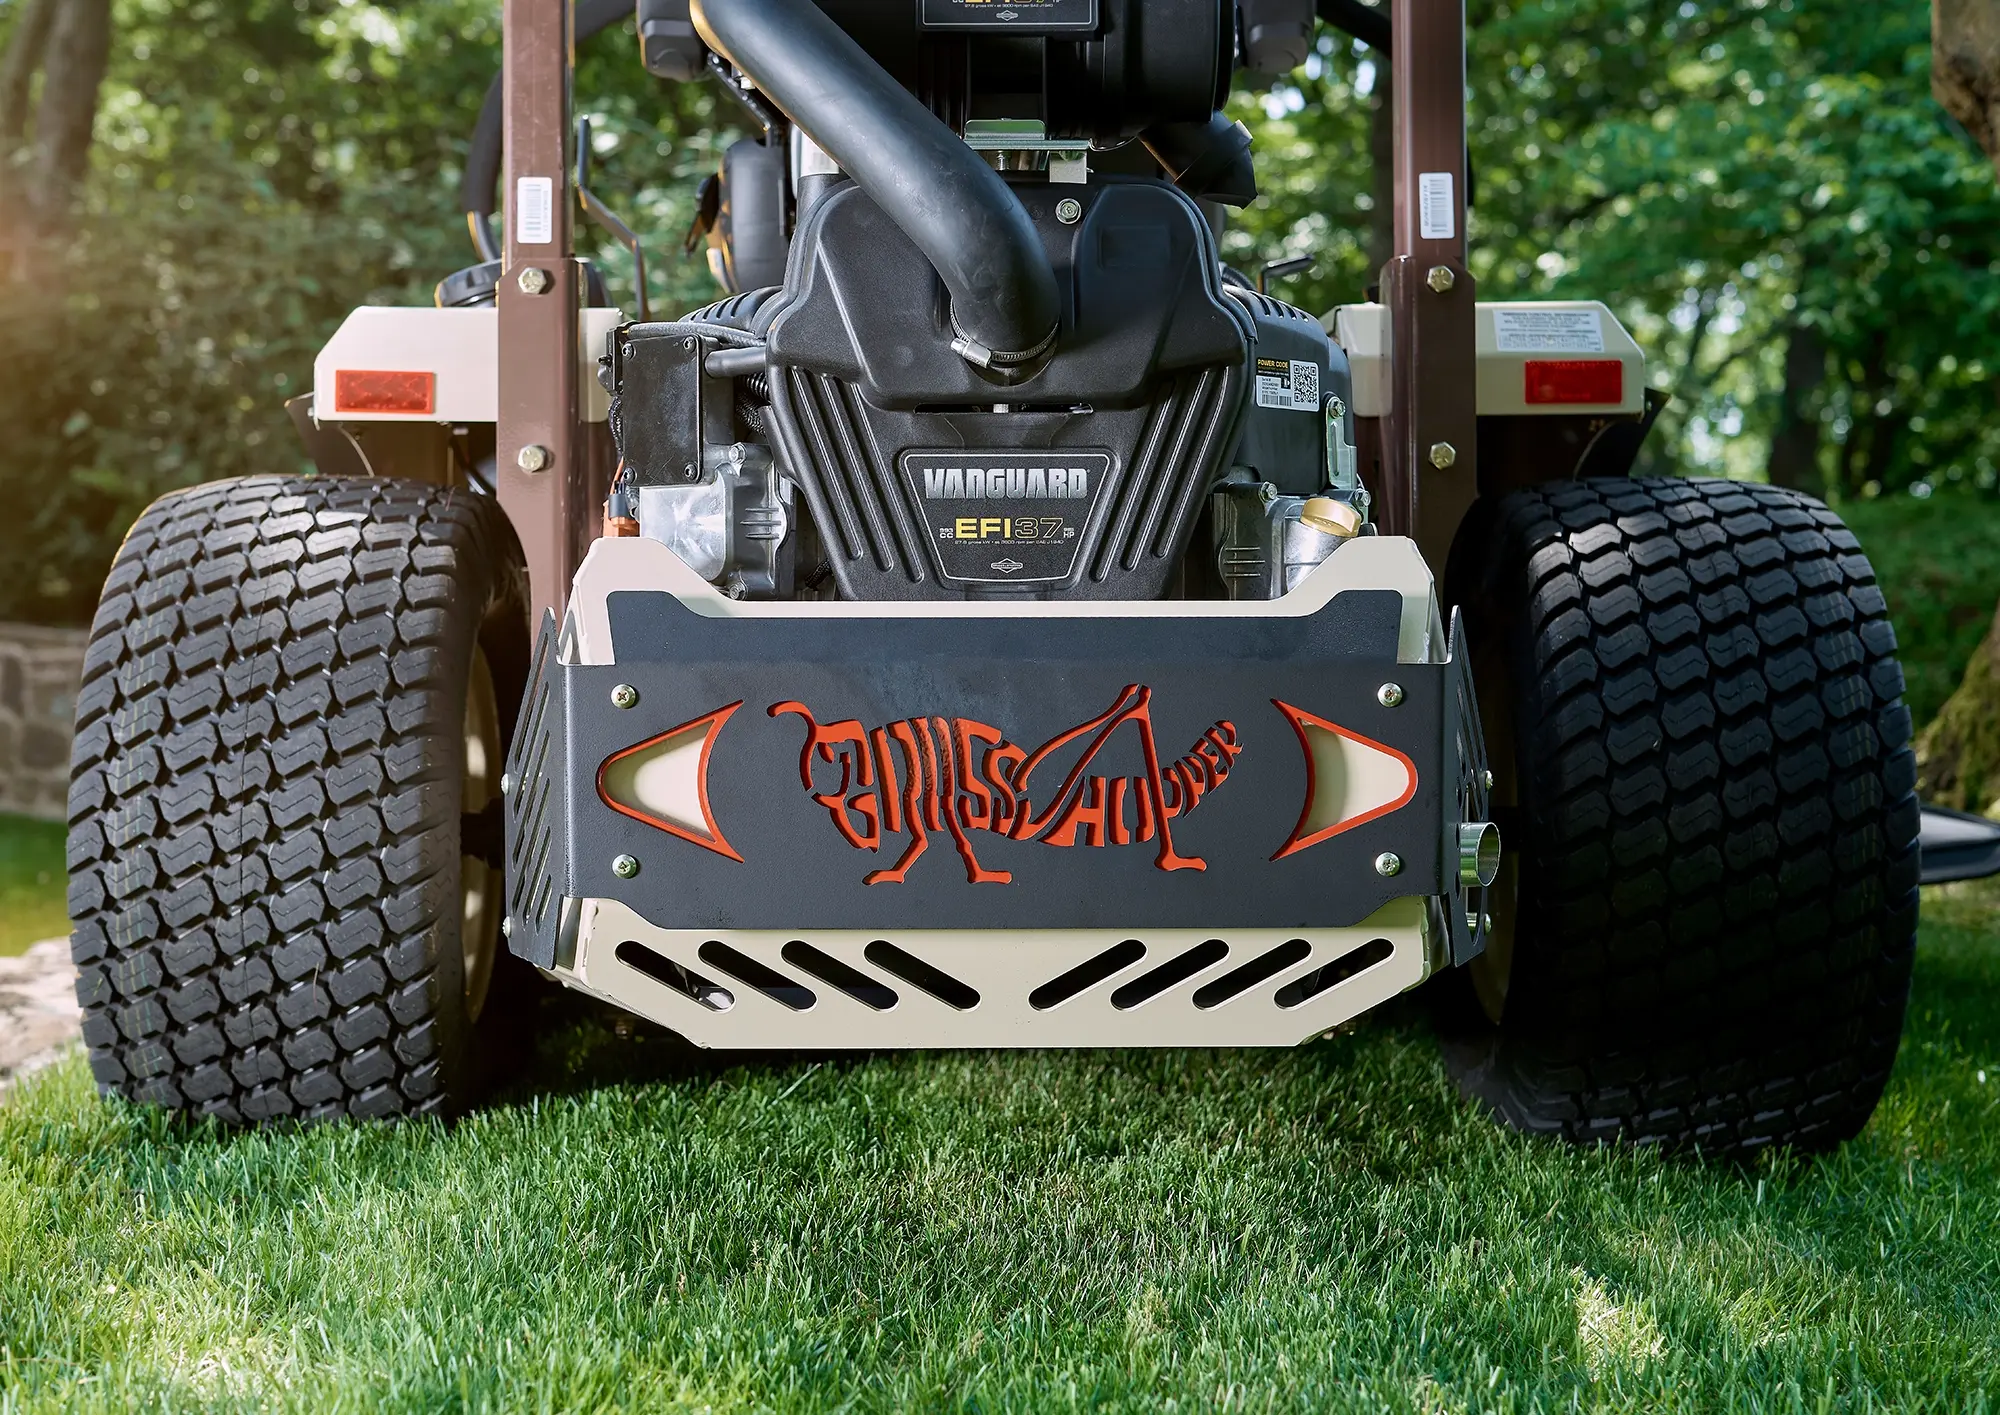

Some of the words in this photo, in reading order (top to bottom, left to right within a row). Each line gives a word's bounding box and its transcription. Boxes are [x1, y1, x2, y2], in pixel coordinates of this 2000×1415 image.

[1257, 358, 1275, 367] POWER
[1275, 360, 1288, 369] CODE
[923, 468, 1088, 499] VANGUARD
[1063, 531, 1075, 539] HP
